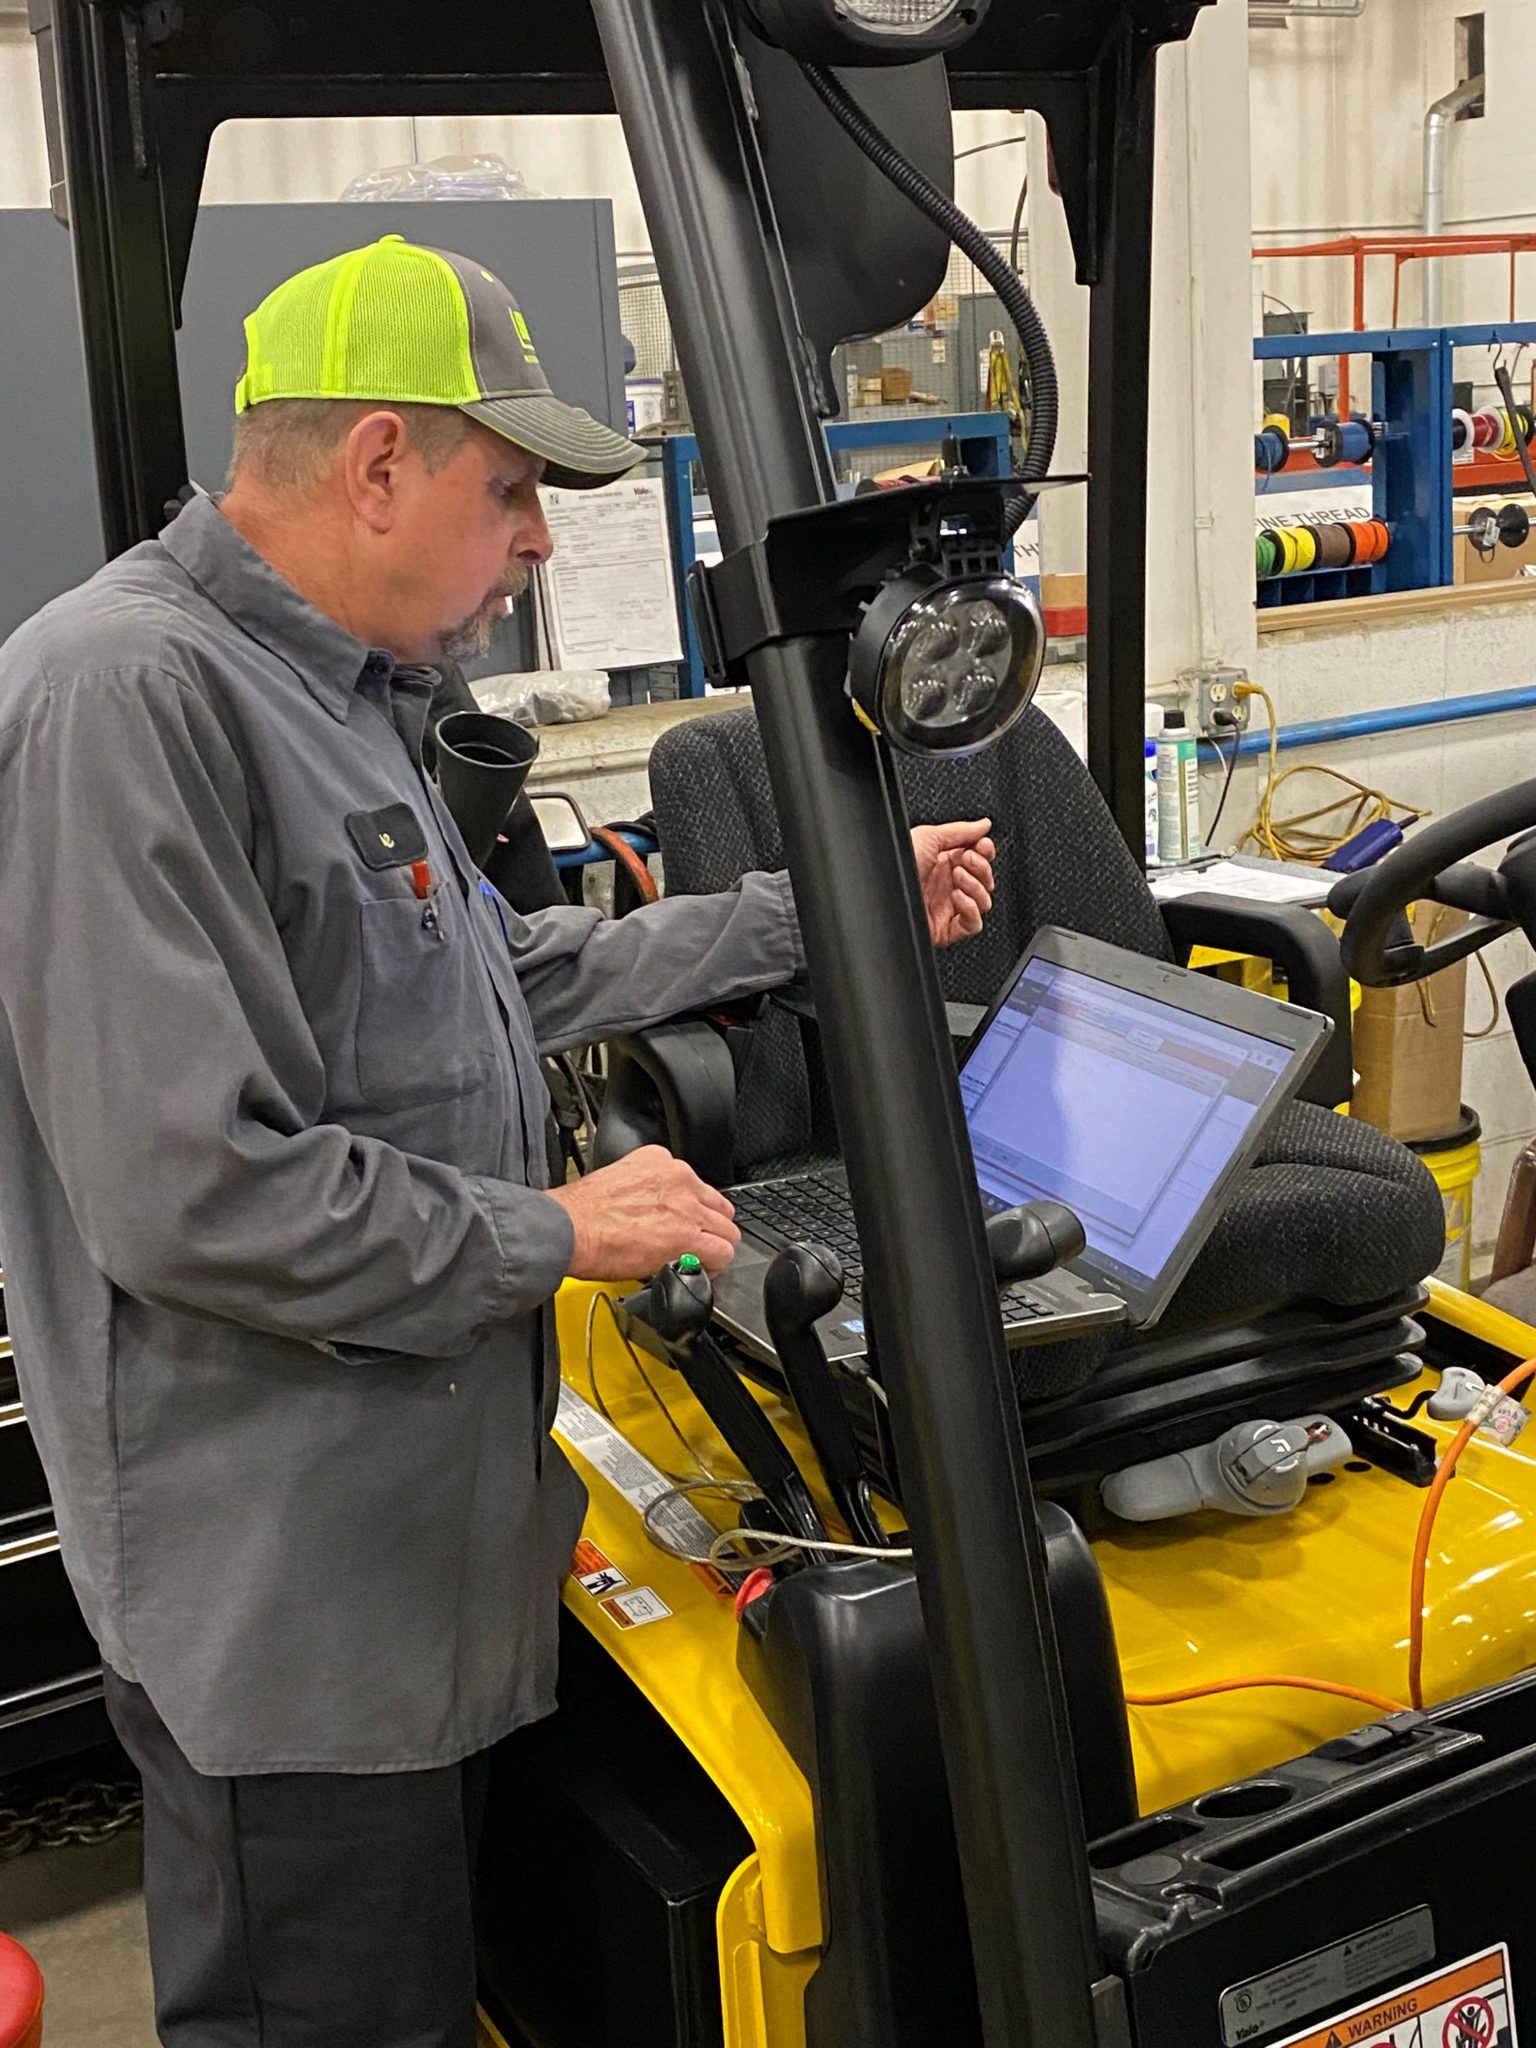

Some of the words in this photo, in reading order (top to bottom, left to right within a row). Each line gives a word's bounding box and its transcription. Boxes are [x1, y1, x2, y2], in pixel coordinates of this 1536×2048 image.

[1255, 516, 1293, 530] INE
[1291, 507, 1371, 525] THREAD
[1348, 1998, 1418, 2039] WARNING
